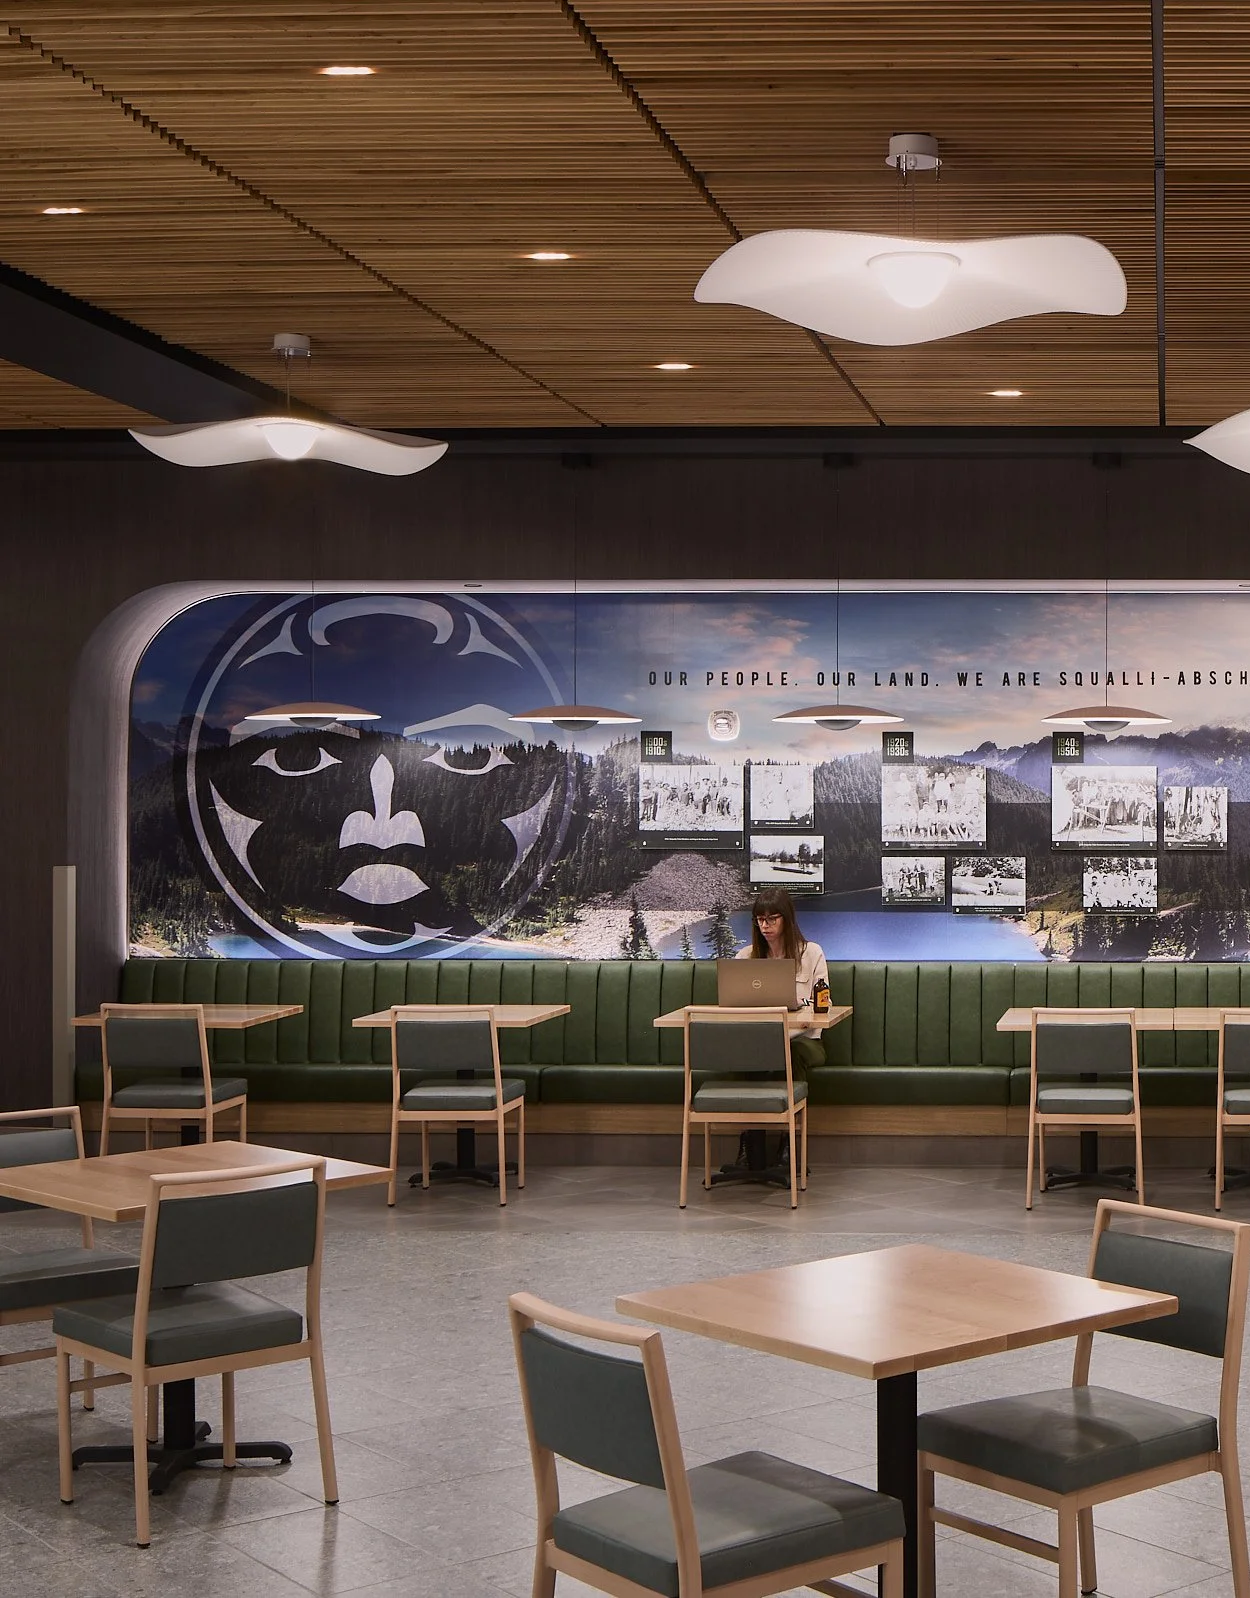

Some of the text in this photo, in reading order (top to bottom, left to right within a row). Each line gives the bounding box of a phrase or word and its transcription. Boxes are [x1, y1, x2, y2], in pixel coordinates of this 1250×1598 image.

[649, 671, 688, 686] OUR
[706, 671, 798, 686] PEOPLE.
[816, 672, 856, 686] OUR
[874, 672, 939, 687] LAND.
[957, 672, 983, 687] WE
[1002, 672, 1041, 686] ARE
[887, 746, 909, 756] 1930s
[1057, 746, 1079, 756] 1950s
